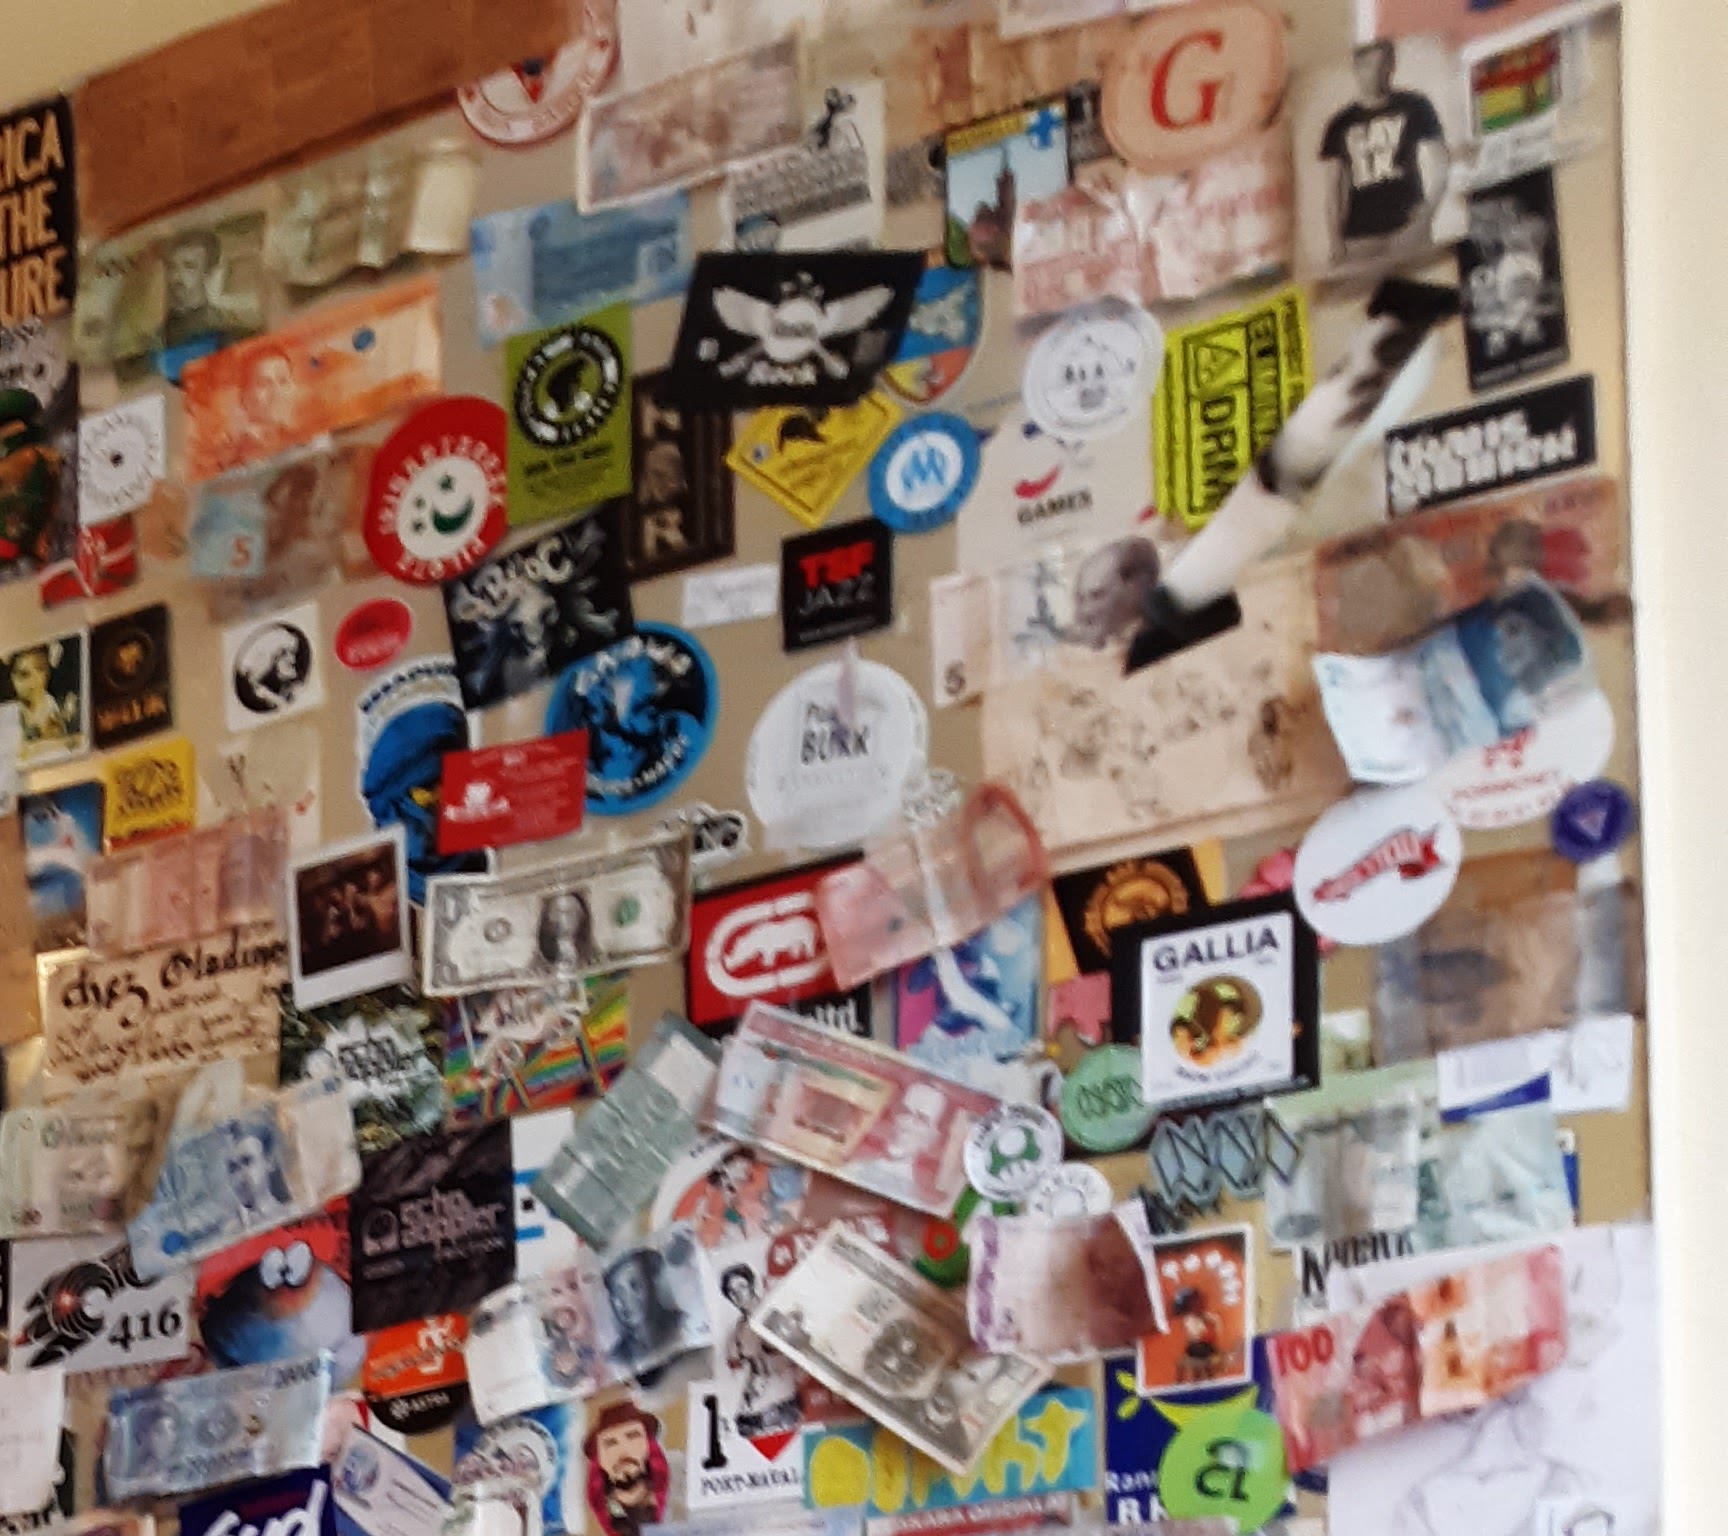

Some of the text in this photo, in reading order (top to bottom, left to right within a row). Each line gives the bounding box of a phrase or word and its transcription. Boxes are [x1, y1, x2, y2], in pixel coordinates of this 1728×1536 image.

[1148, 29, 1225, 131] G
[1151, 926, 1280, 975] GALLIA
[106, 1298, 184, 1353] 416
[1274, 1328, 1335, 1377] 100
